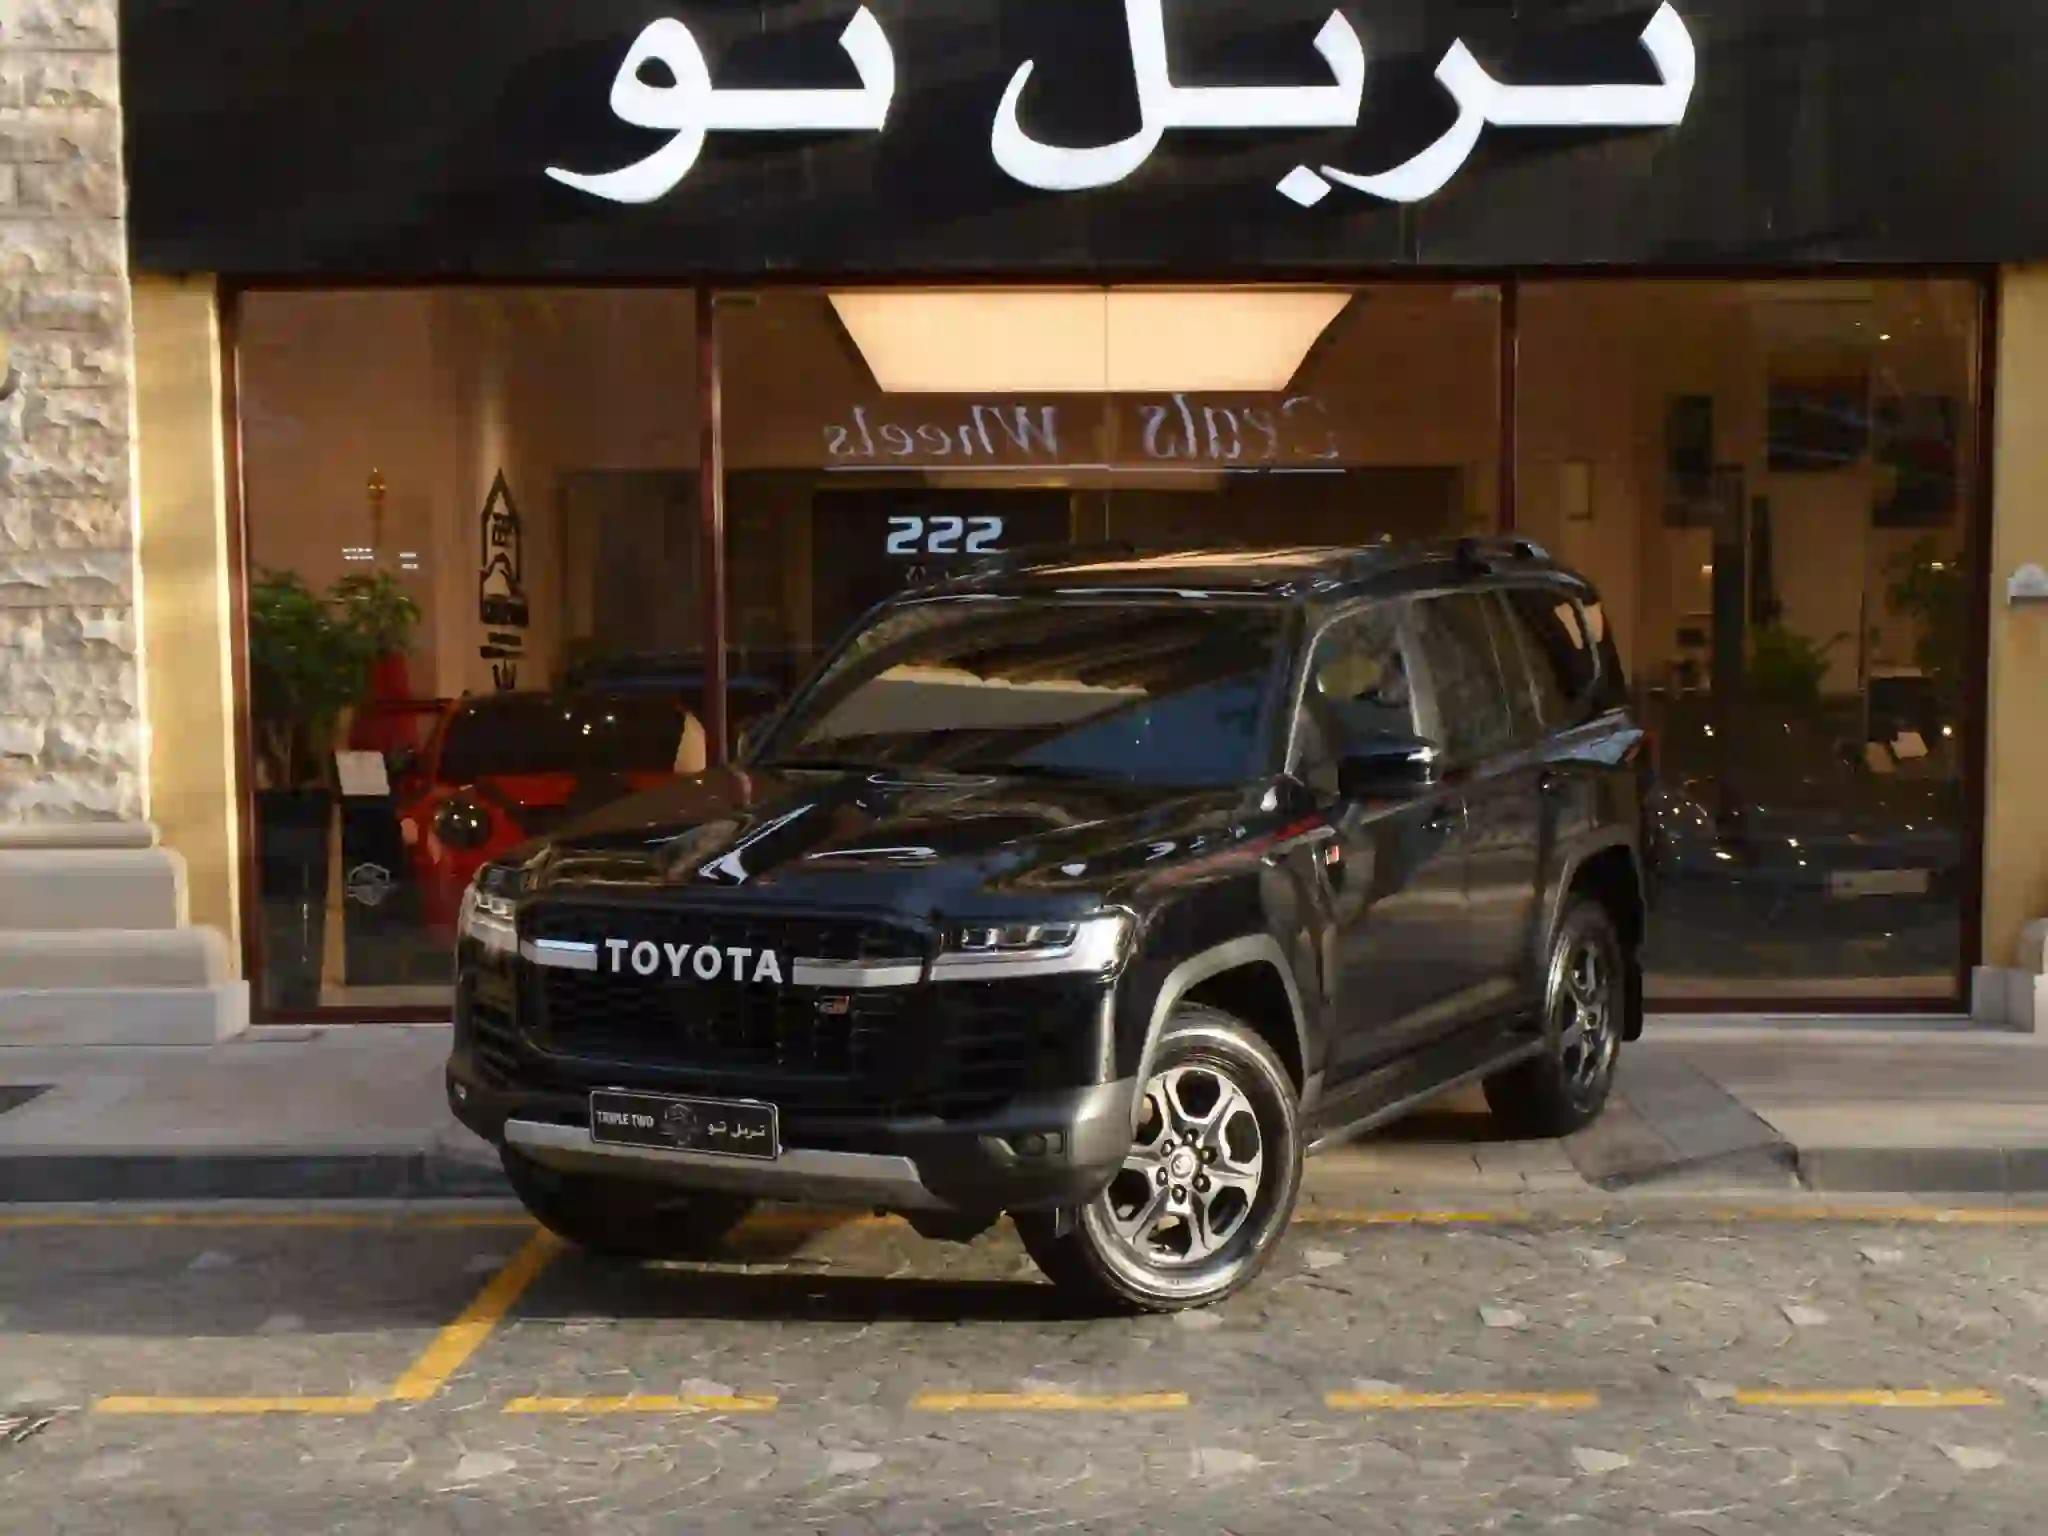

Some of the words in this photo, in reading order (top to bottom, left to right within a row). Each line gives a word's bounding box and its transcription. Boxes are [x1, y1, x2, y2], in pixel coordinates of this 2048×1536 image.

[886, 515, 1004, 554] 222
[605, 938, 784, 984] TOYOTA
[631, 1114, 655, 1128] TWO
